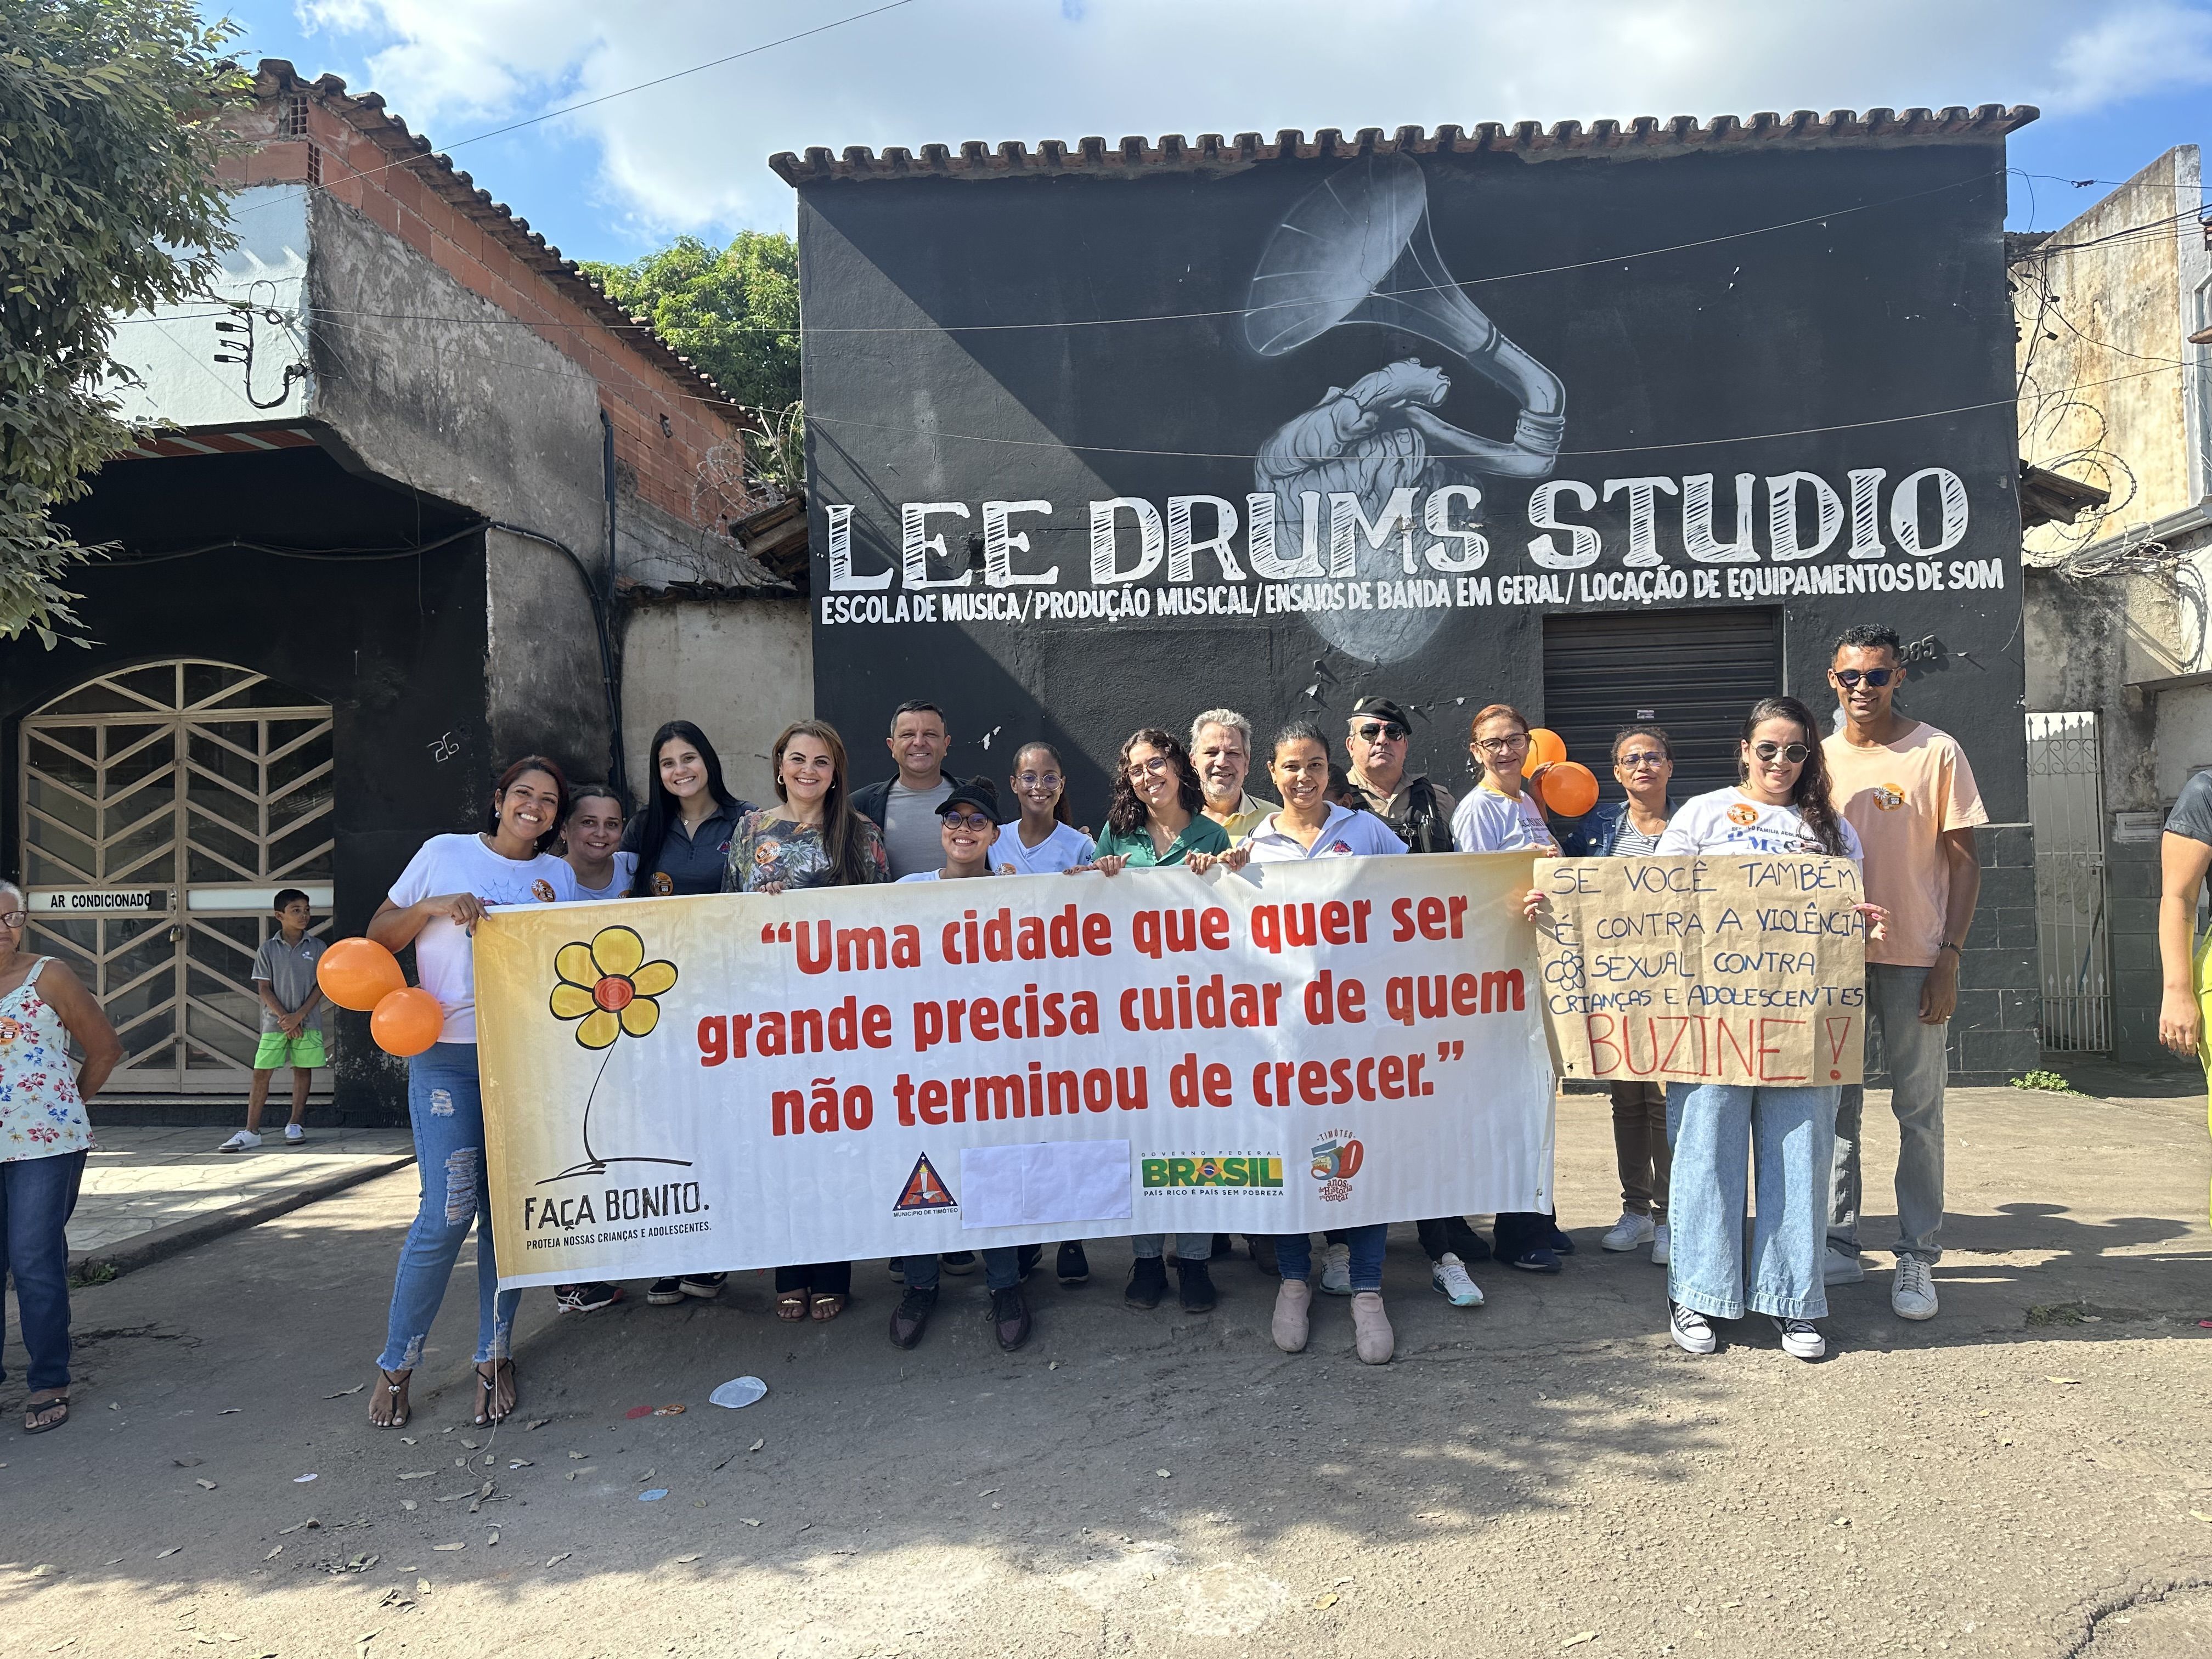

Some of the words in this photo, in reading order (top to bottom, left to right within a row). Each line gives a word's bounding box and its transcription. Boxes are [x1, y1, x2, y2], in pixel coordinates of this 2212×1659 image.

[825, 500, 1059, 591] LEE
[1089, 483, 1490, 586] DRUMS
[1527, 466, 1970, 569] STUDIO
[821, 595, 911, 625] ESCOLA
[913, 594, 937, 623] DE
[1347, 582, 1373, 611] DE
[1376, 578, 1452, 610] BANDA
[1456, 576, 1492, 607] EM
[1579, 564, 1689, 605] LOCAÇÃO
[1692, 568, 1722, 600] DE
[1727, 562, 1915, 601] EQUIPAMENTOS
[1915, 561, 1945, 592] DE
[1947, 557, 2005, 590] SOM
[1757, 826, 1779, 835] FAMILIA
[1551, 866, 1601, 895] SE
[1624, 860, 1717, 893] VOCÊ
[1739, 860, 1857, 892] TAMBÉM
[50, 895, 65, 908] AR
[71, 893, 152, 908] CONDICIONADO
[942, 904, 1112, 965] cidade
[1132, 907, 1230, 960] que
[1250, 899, 1372, 954] quer
[1391, 895, 1468, 944] ser
[1555, 913, 1580, 946] É
[1596, 911, 1705, 940] CONTRA
[1716, 907, 1743, 935] A
[1757, 902, 1865, 940] VIOLÊNCIA
[1591, 951, 1696, 982] SEXUAL
[1713, 951, 1815, 975] CONTRA
[697, 995, 893, 1068] grande
[913, 983, 1099, 1052] precisa
[1120, 973, 1283, 1032] cuidar
[1304, 968, 1367, 1026] de
[1386, 967, 1526, 1027] quem
[1548, 989, 1652, 1015] CRIANÇAS
[1664, 988, 1679, 1005] E
[1688, 984, 1865, 1007] ADOLESCENTES
[1587, 1013, 1808, 1081] BUZINE
[771, 1076, 874, 1137] não
[893, 1061, 1148, 1127] terminou
[1169, 1052, 1233, 1109] de
[1141, 1158, 1284, 1188] BRASIL
[524, 1194, 596, 1232] FAÇA
[605, 1181, 710, 1222] BONITO.
[1325, 1193, 1348, 1202] contar
[526, 1237, 561, 1250] PROTEJA
[563, 1233, 595, 1246] NOSSAS
[597, 1229, 638, 1242] CRIANÇAS
[641, 1228, 646, 1238] E
[648, 1221, 712, 1238] ADOLESCENTES.
